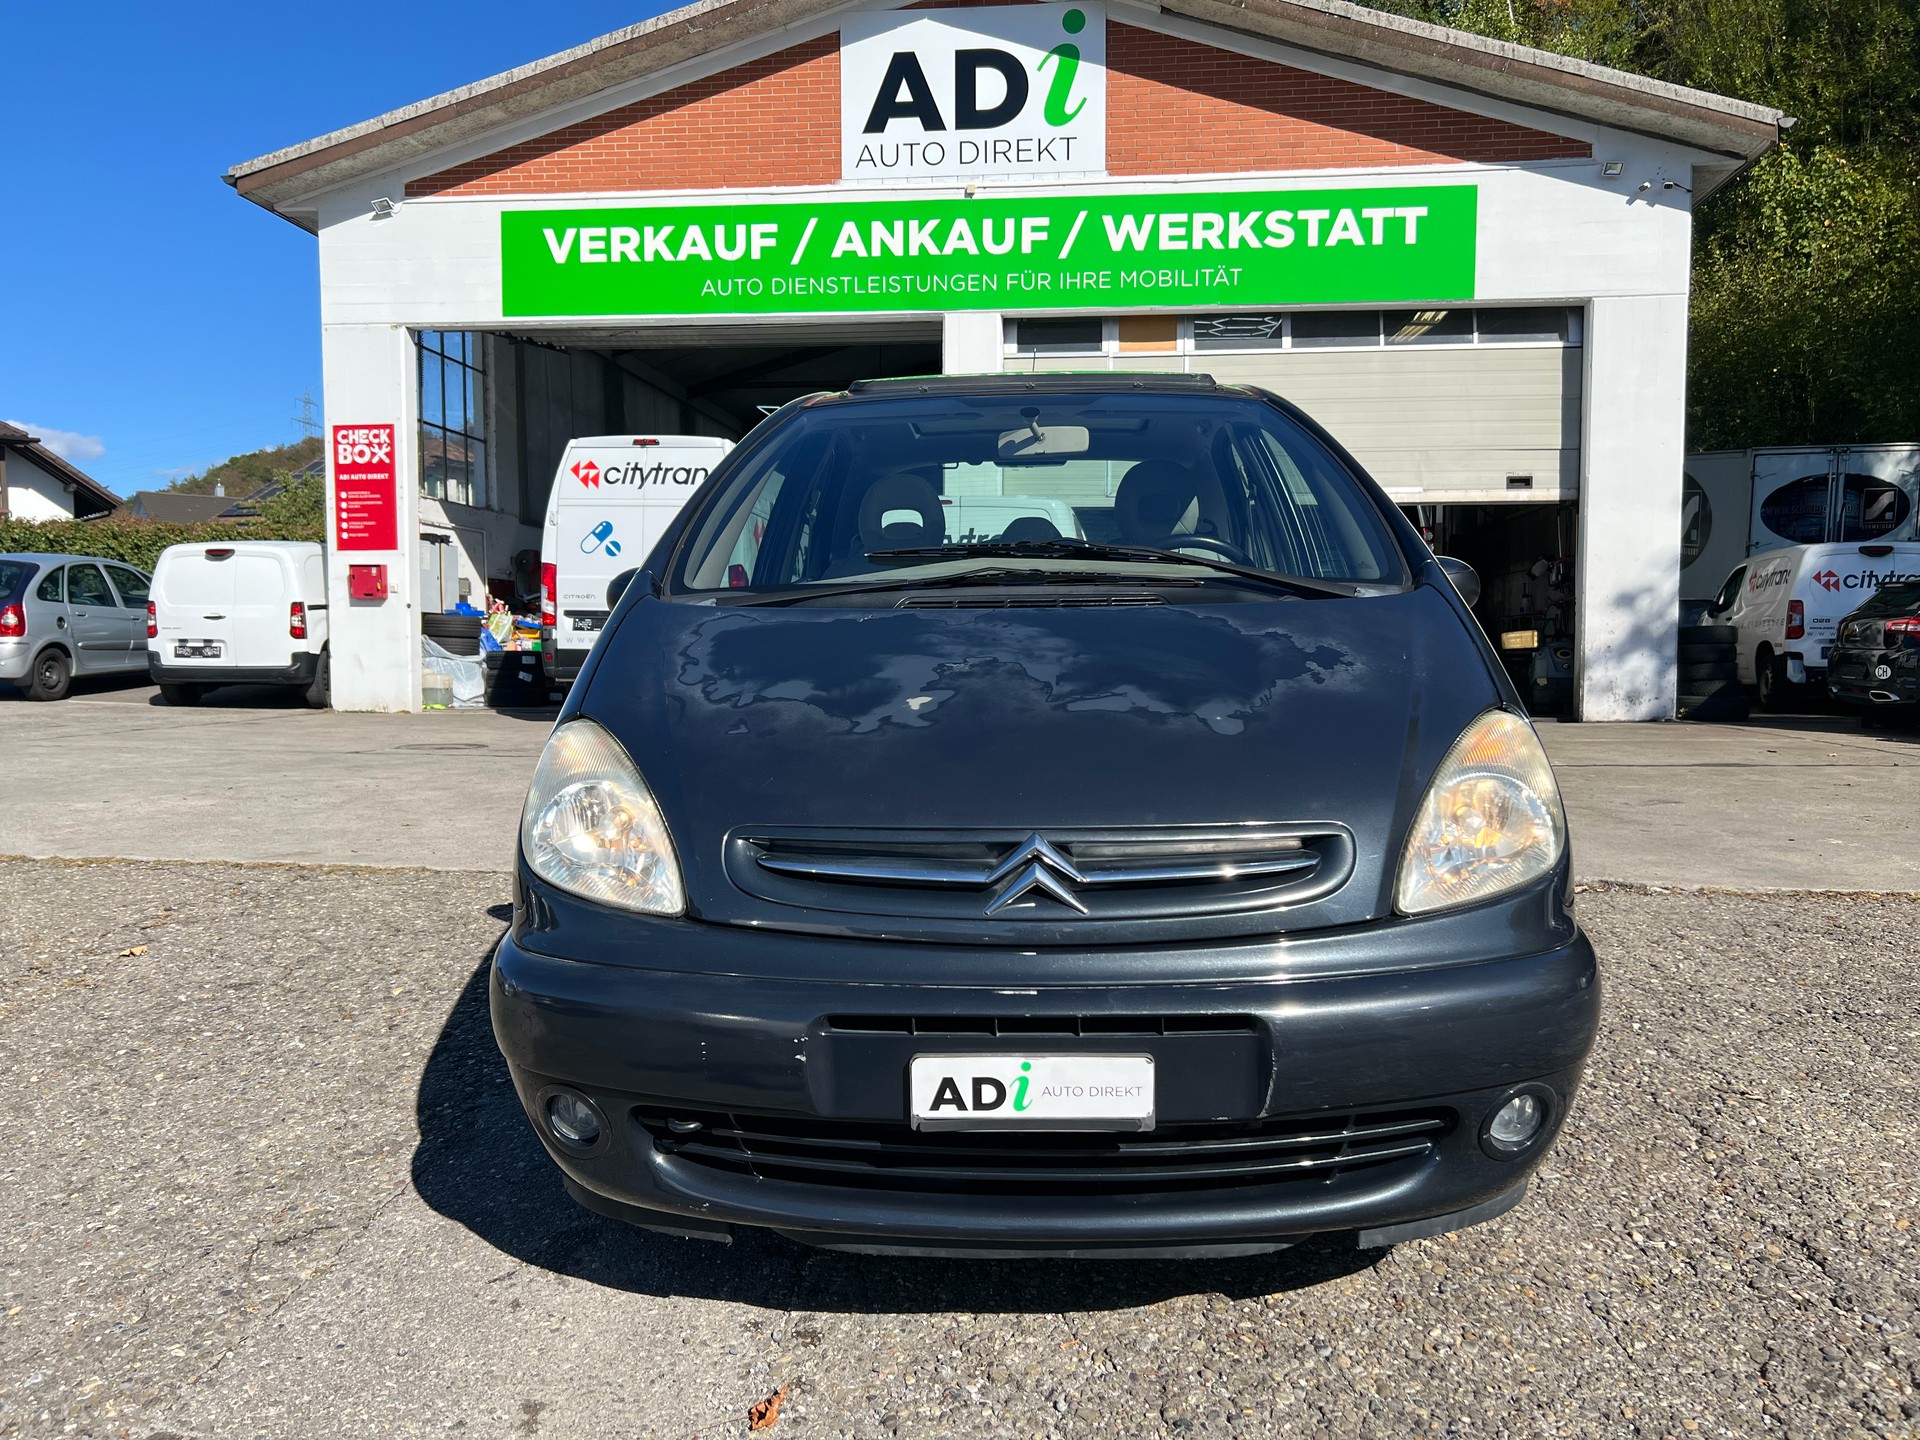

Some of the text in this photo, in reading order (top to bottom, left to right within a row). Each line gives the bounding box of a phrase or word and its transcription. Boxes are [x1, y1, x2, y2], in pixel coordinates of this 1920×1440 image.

[862, 8, 1088, 134] ADi
[855, 136, 1078, 168] AUTO DIREKT
[542, 206, 1428, 265] VERKAUF / ANKAUF / WERKSTATT
[701, 265, 1243, 297] AUTO DIENSTLEISTUNGEN FÜR IHRE MOBILITÄT
[337, 429, 391, 444] CHECK
[337, 444, 391, 465] BOX
[350, 473, 367, 481] AUTO
[1877, 666, 1888, 677] CH
[928, 1061, 1143, 1112] ADi AUTO DIREKT
